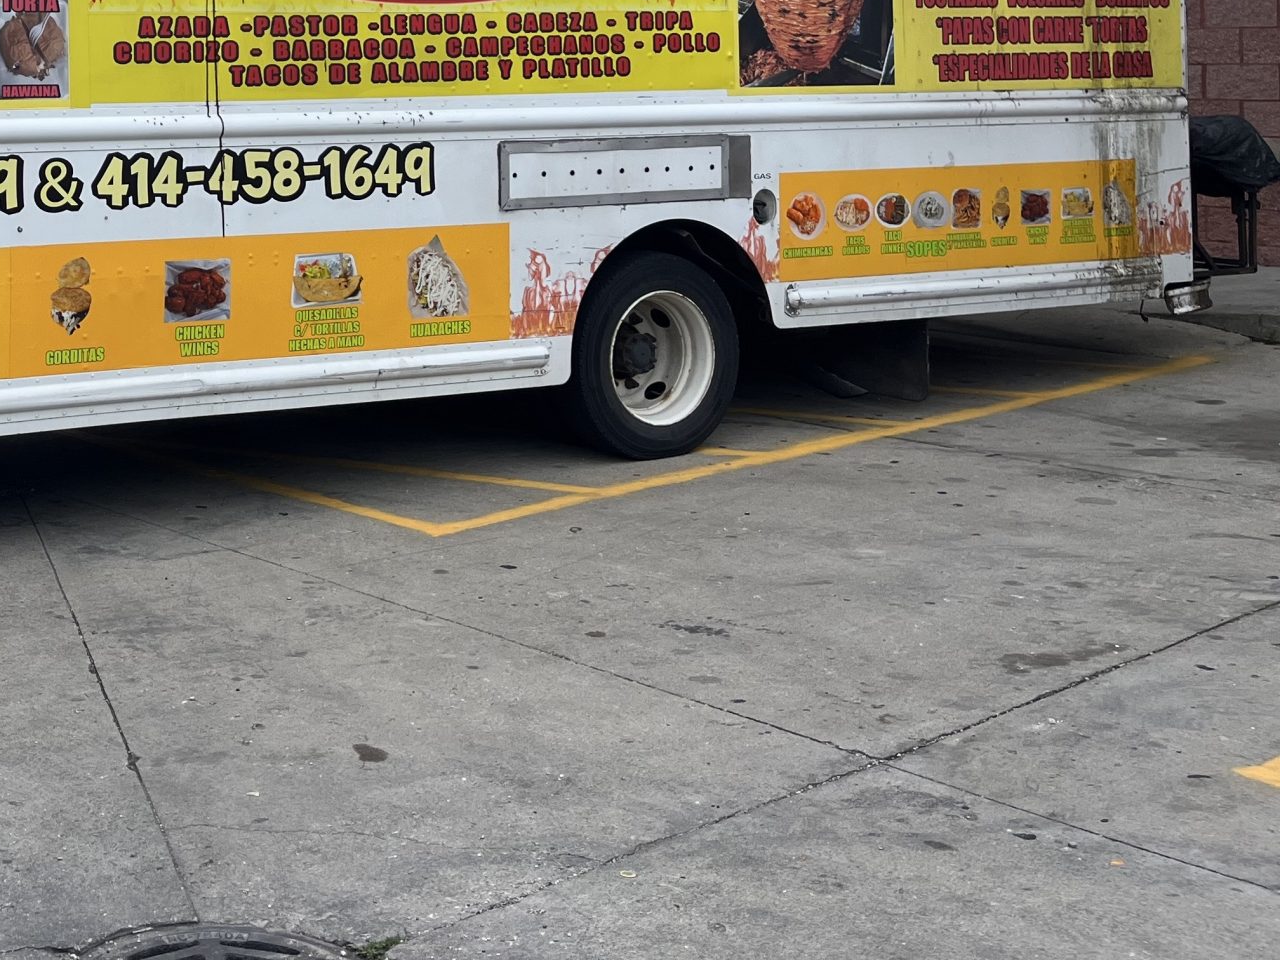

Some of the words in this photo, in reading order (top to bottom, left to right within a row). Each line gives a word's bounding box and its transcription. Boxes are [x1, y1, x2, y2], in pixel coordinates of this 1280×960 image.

[138, 16, 230, 38] AZADA
[506, 12, 598, 33] CABEZA
[625, 11, 693, 31] TRIPA
[997, 17, 1031, 44] CON
[1033, 16, 1083, 43] CARNE
[113, 41, 239, 64] CHORIZO
[273, 38, 415, 61] BARBACOA
[446, 34, 625, 58] CAMPECHANOS
[653, 32, 720, 53] POLLO
[229, 63, 318, 87] TACOS
[329, 63, 361, 84] DE
[371, 60, 489, 83] ALAMBRE
[498, 59, 512, 80] Y
[522, 56, 631, 79] PLATILLO
[1071, 52, 1090, 79] DE
[1092, 52, 1111, 79] LA
[1113, 51, 1153, 78] CASA
[2, 85, 59, 97] HAWAINA
[36, 159, 82, 212] &
[93, 142, 434, 210] 414-458-1649
[884, 231, 902, 241] TACO
[783, 246, 833, 259] CHIMICHANGAS
[881, 243, 906, 254] DINNER
[906, 240, 947, 258] SOPES
[295, 307, 358, 323] QUESADILLAS
[175, 324, 225, 341] CHICKEN
[293, 323, 310, 337] C/
[311, 321, 360, 335] TORTILLAS
[410, 320, 470, 337] HUARACHES
[180, 342, 219, 357] WINGS
[288, 337, 327, 351] HECHAS
[328, 337, 336, 349] A
[337, 335, 364, 349] MANO
[45, 347, 105, 366] GORDITAS
